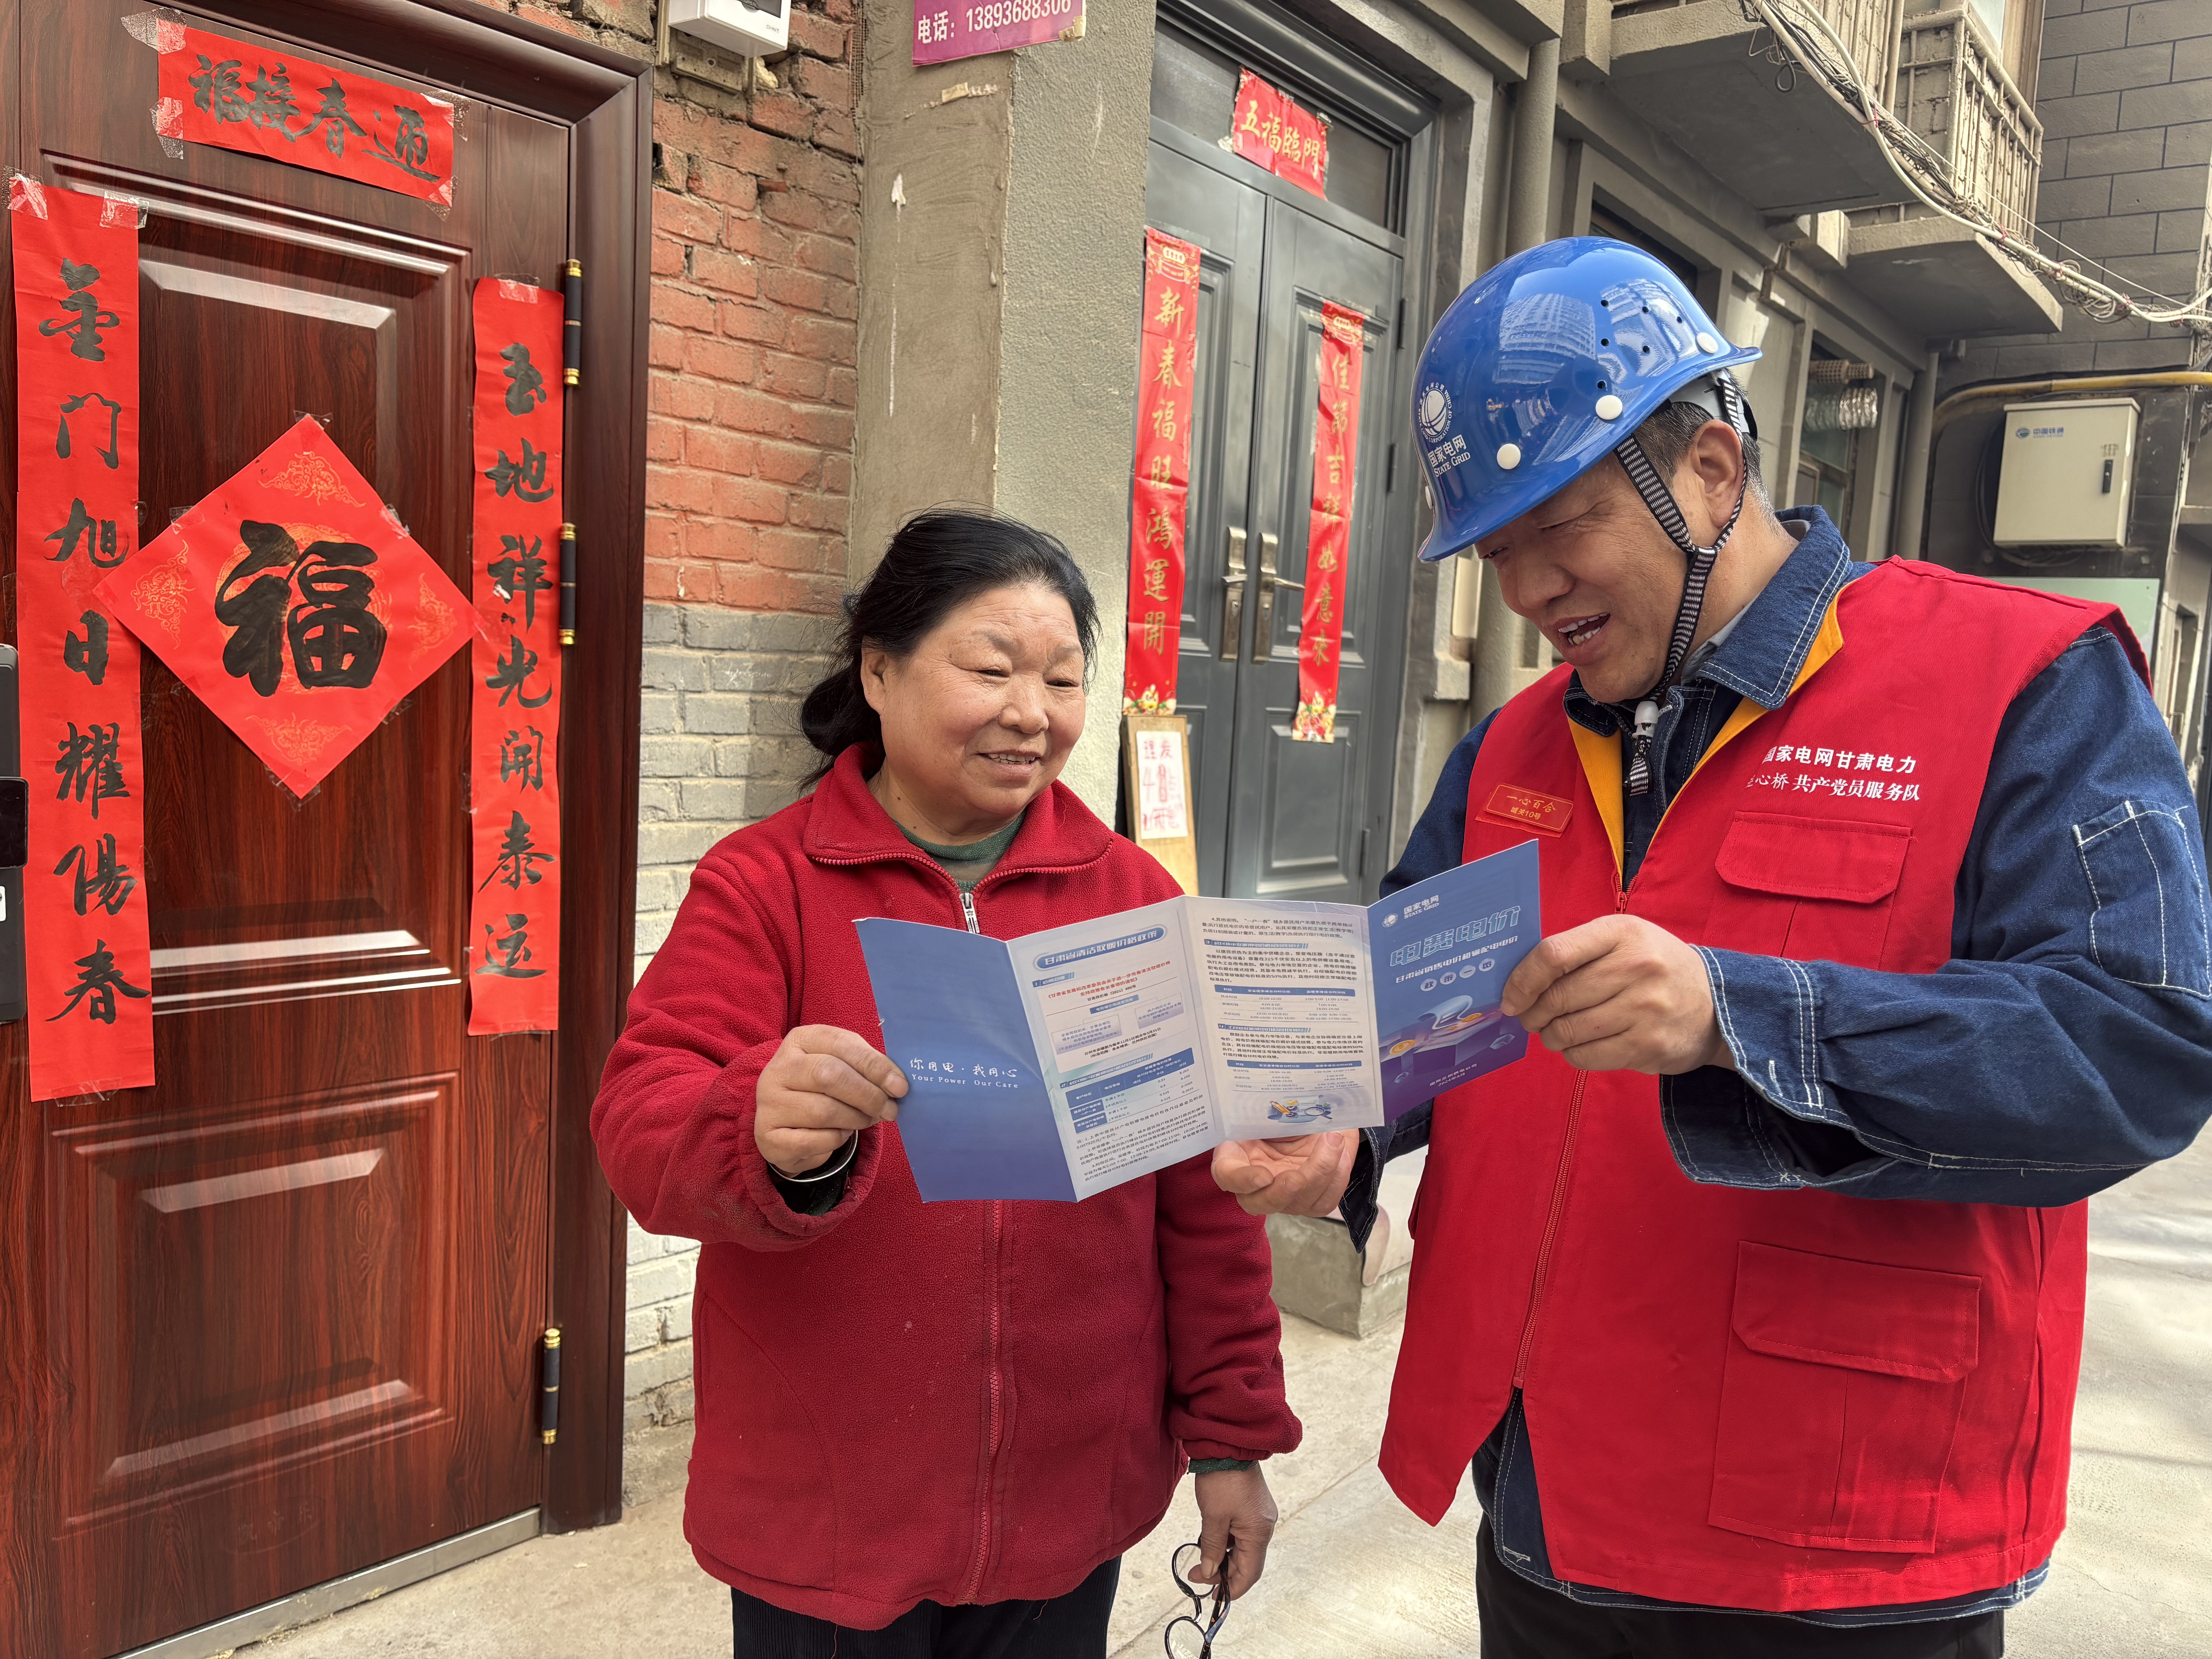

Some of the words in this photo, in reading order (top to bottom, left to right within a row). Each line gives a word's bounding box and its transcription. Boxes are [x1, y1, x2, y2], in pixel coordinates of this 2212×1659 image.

[1428, 434, 1467, 467] 国家电网
[1434, 462, 1451, 477] STATE
[1451, 452, 1470, 466] GRID
[214, 519, 388, 697] 福
[1762, 745, 1916, 774] 国家电网甘肃电力
[1791, 774, 1920, 801] 共产党员服务队
[1507, 795, 1556, 812] 一心百合
[1404, 895, 1439, 914] 国家电网
[1390, 905, 1521, 967] 电费电价
[938, 1077, 966, 1085] Power
